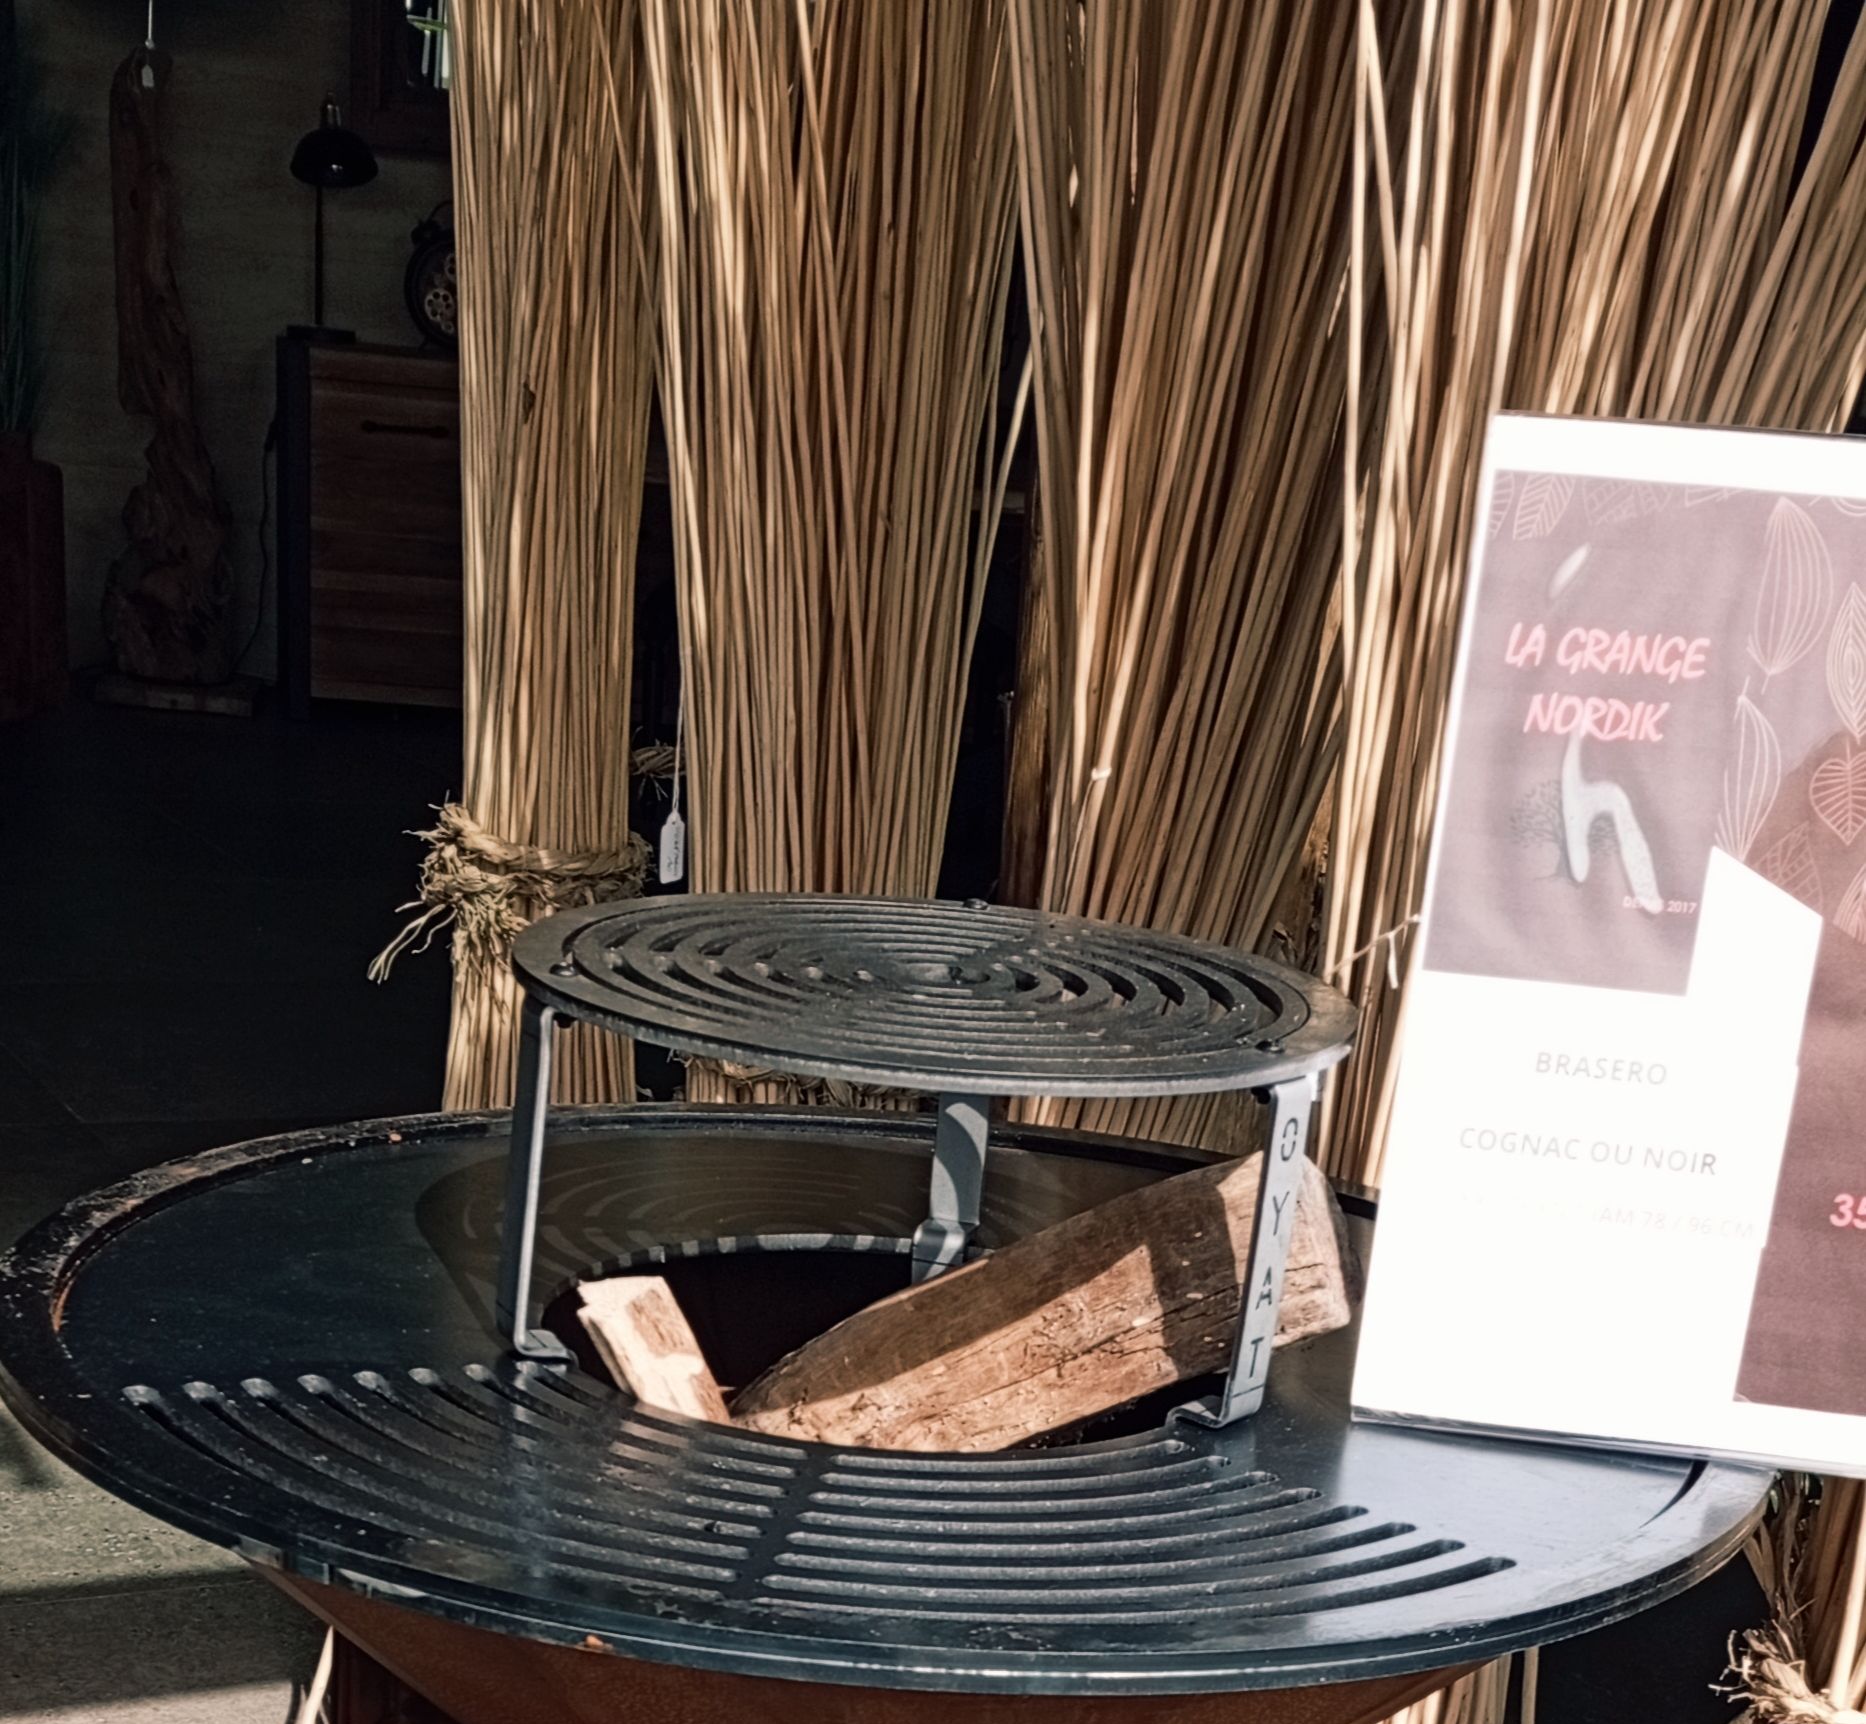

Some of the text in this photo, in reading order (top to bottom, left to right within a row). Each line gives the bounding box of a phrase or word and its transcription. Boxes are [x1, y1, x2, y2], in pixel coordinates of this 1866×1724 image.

[1505, 622, 1710, 684] LA GRANGE
[1523, 692, 1669, 742] NORDIK
[1667, 894, 1696, 913] 2017
[1535, 1051, 1668, 1085] BRASERO
[1459, 1128, 1717, 1175] COGNAC OU NOIR
[1249, 1117, 1298, 1378] OYAT
